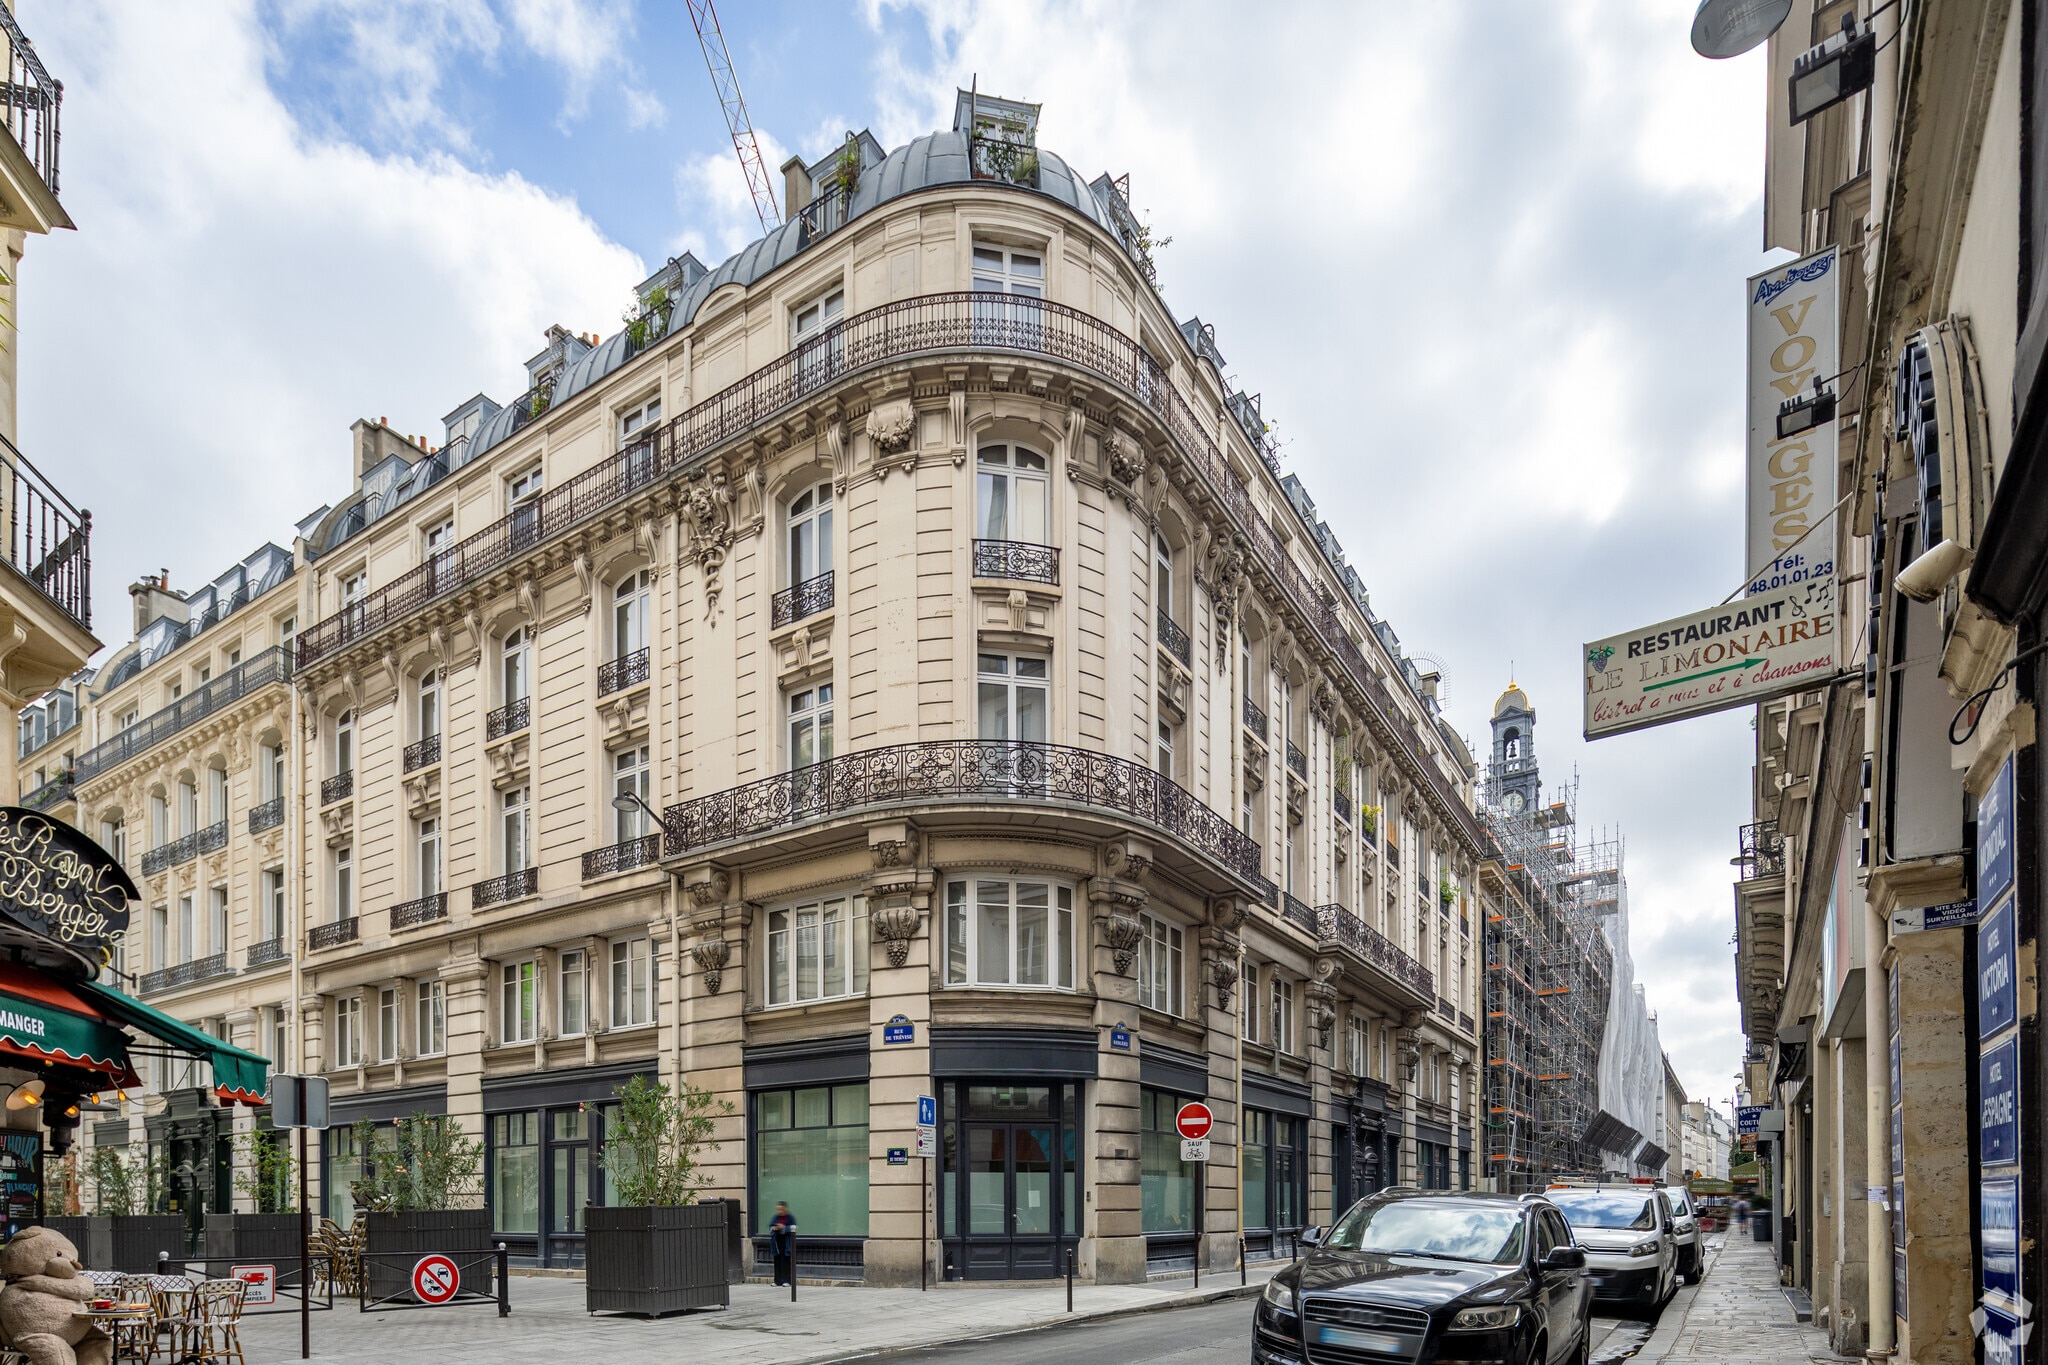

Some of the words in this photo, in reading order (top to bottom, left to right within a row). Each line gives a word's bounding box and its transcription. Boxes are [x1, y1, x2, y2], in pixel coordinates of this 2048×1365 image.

[1767, 295, 1817, 550] VOYGES
[1750, 561, 1833, 594] 48.01.01.23
[1774, 554, 1804, 572] Tél:
[1628, 600, 1785, 659] RESTAURANT
[1587, 668, 1623, 695] LE
[1639, 613, 1834, 682] LIMONAIRE
[1594, 695, 1646, 722] bistrot
[1708, 676, 1726, 694] et
[1733, 673, 1744, 688] à
[1752, 654, 1833, 684] chansons
[0, 811, 12, 845] e
[1980, 817, 2007, 878] MONDIAL
[1926, 910, 1979, 924] SURVEILLANC
[1934, 903, 1951, 912] SITE
[1952, 900, 1973, 909] SOUS
[1941, 907, 1966, 916] VIDÉO
[1981, 952, 2009, 1002] VICTORIA
[0, 1010, 45, 1037] MANGER
[7, 1135, 39, 1173] HOUR
